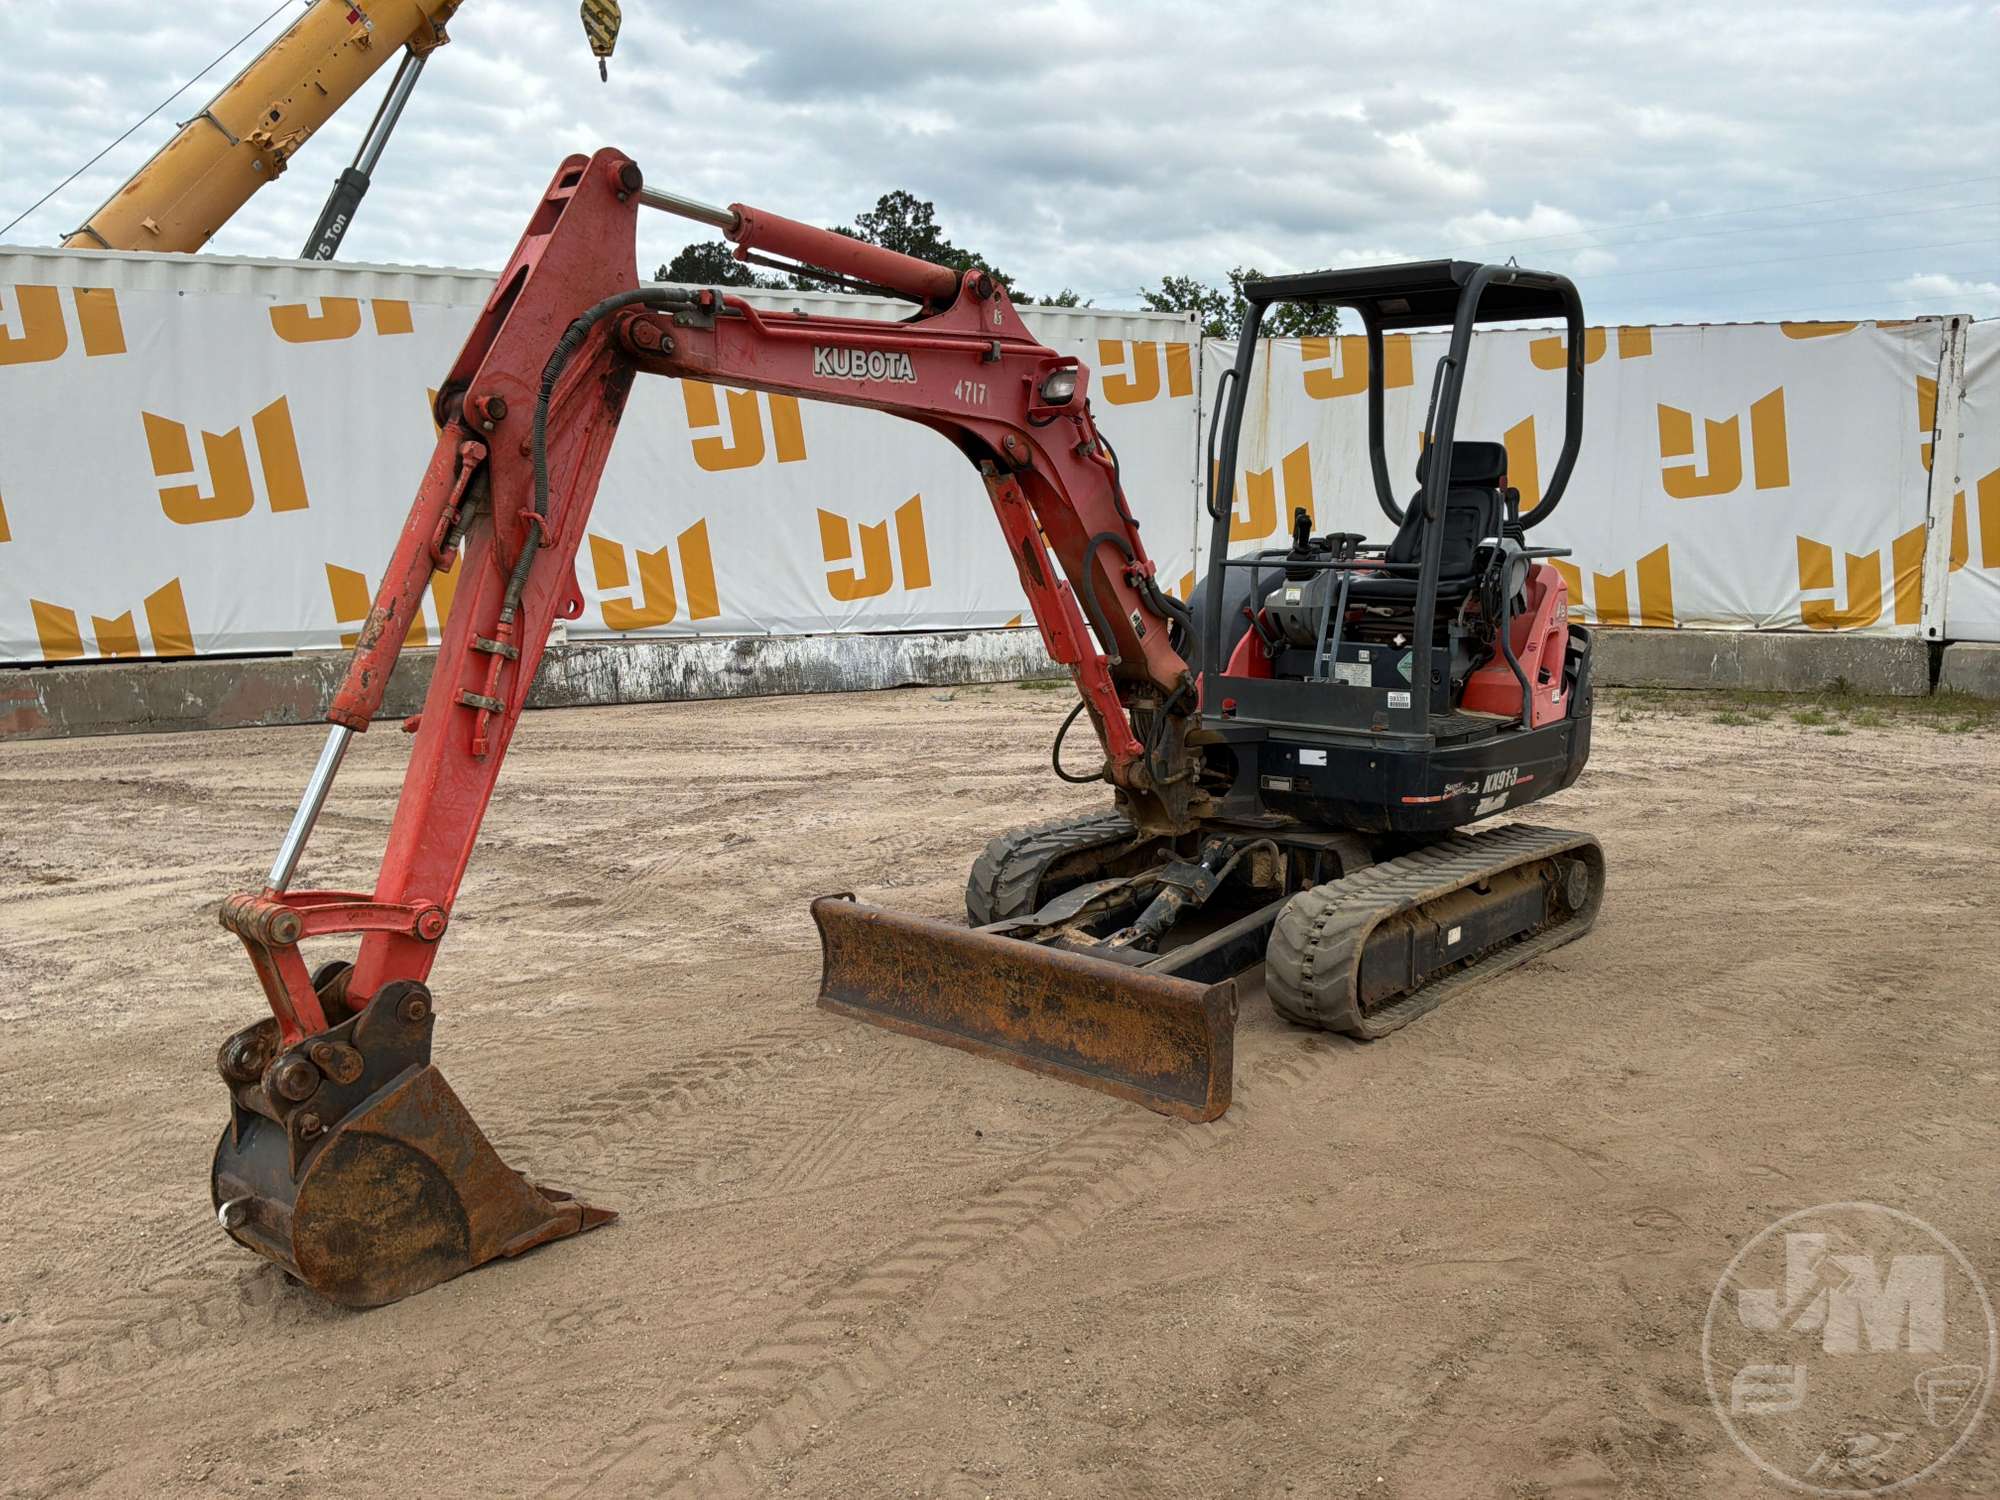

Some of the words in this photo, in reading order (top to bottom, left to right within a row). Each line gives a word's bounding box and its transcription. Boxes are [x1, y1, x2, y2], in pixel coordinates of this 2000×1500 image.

[324, 214, 347, 241] Ton
[813, 346, 917, 384] KUBOTA
[954, 379, 988, 406] 4717
[1469, 782, 1480, 793] 2
